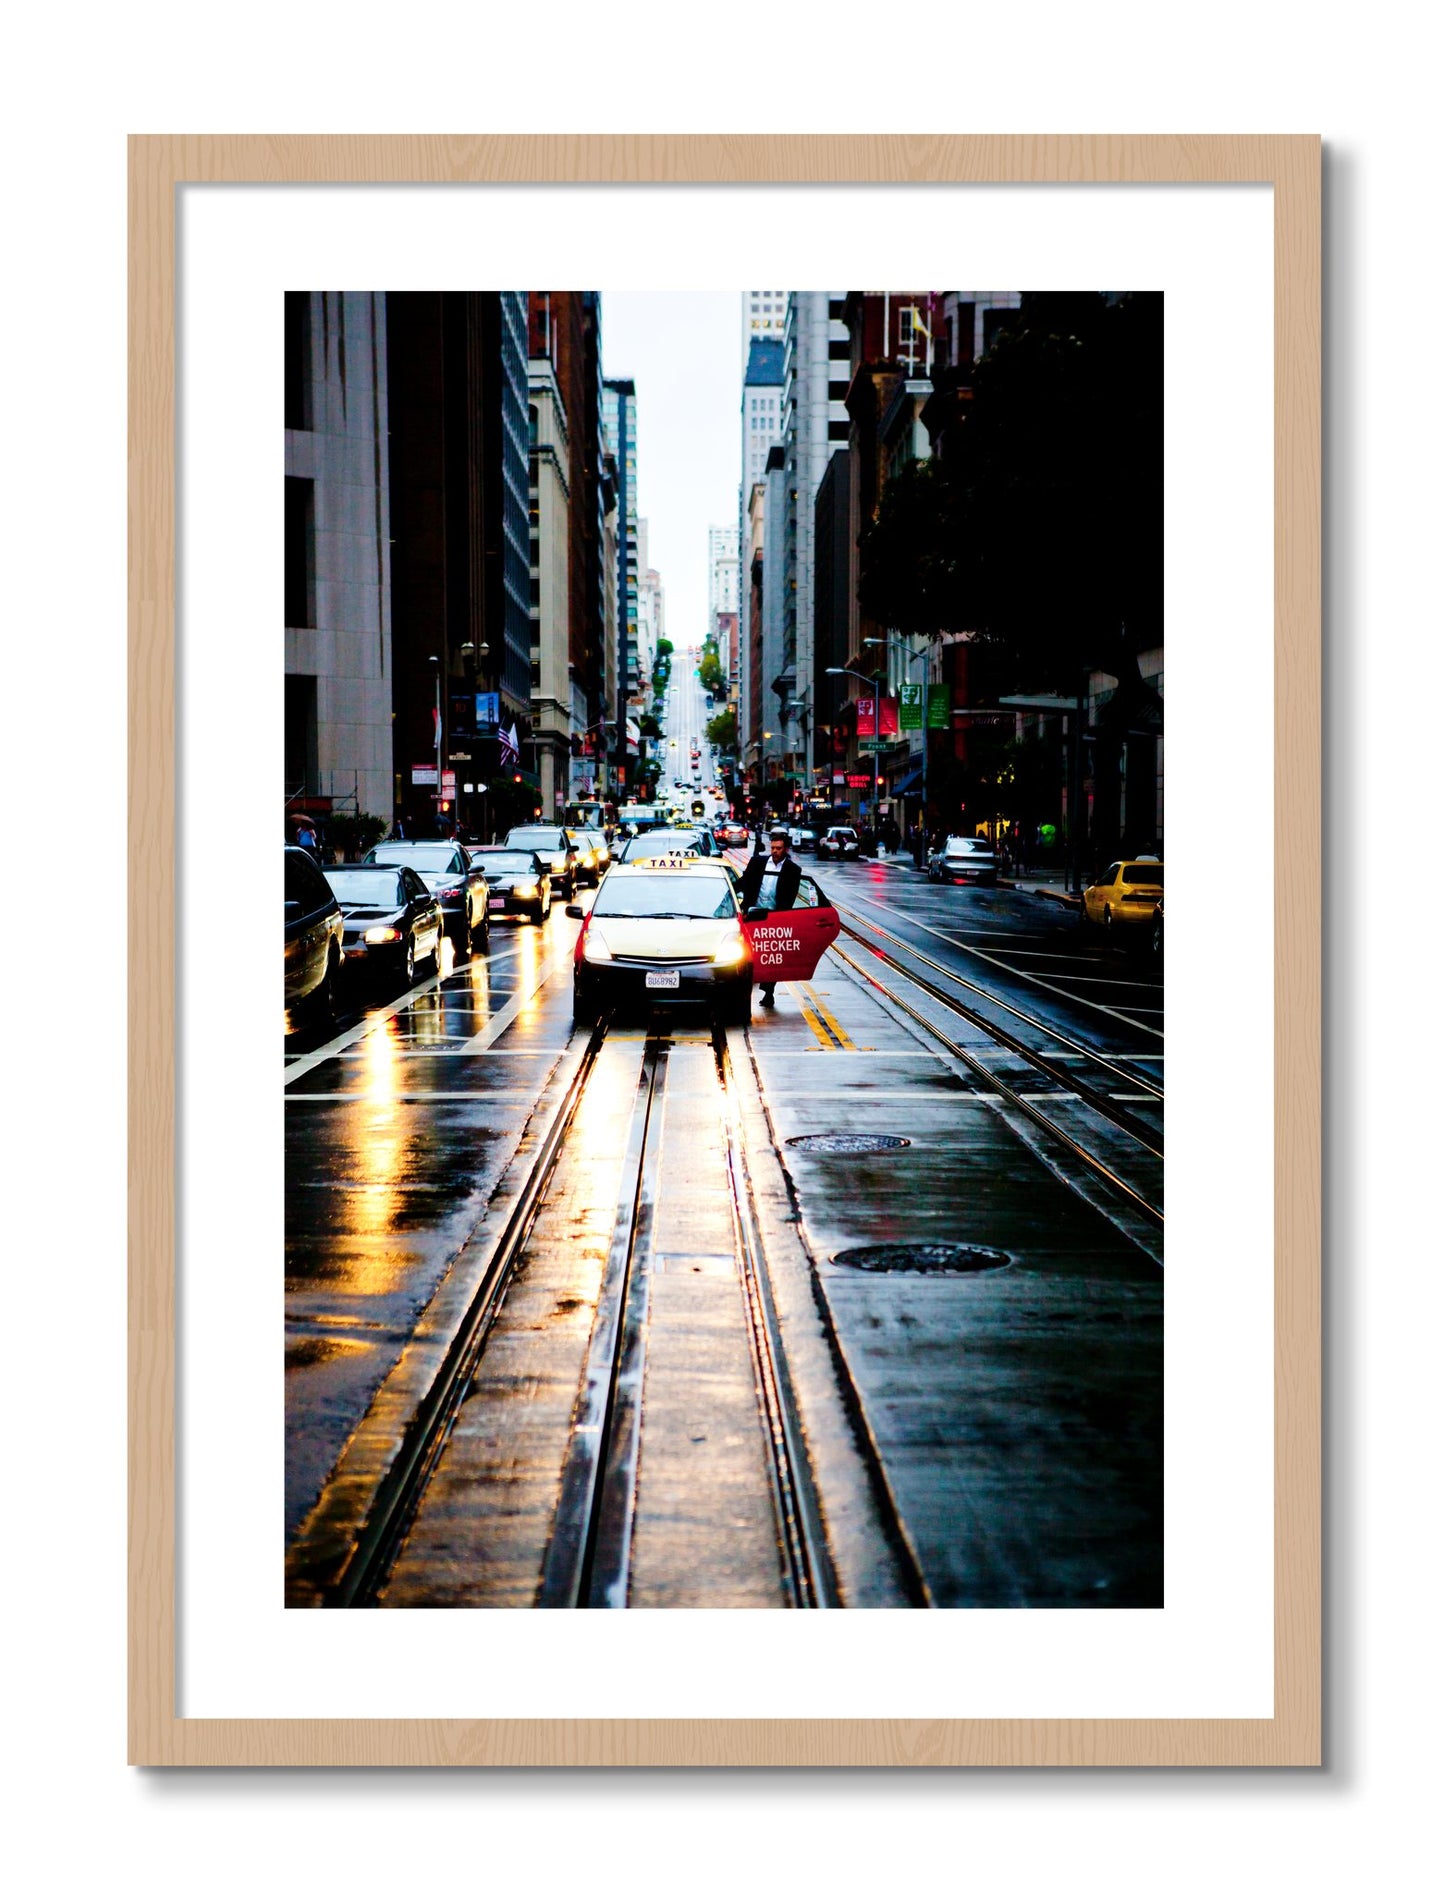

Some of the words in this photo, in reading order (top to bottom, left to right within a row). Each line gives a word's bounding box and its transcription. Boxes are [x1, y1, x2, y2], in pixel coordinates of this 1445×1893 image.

[651, 859, 683, 868] TAXI
[753, 927, 793, 939] ARROW
[760, 953, 783, 965] CAB
